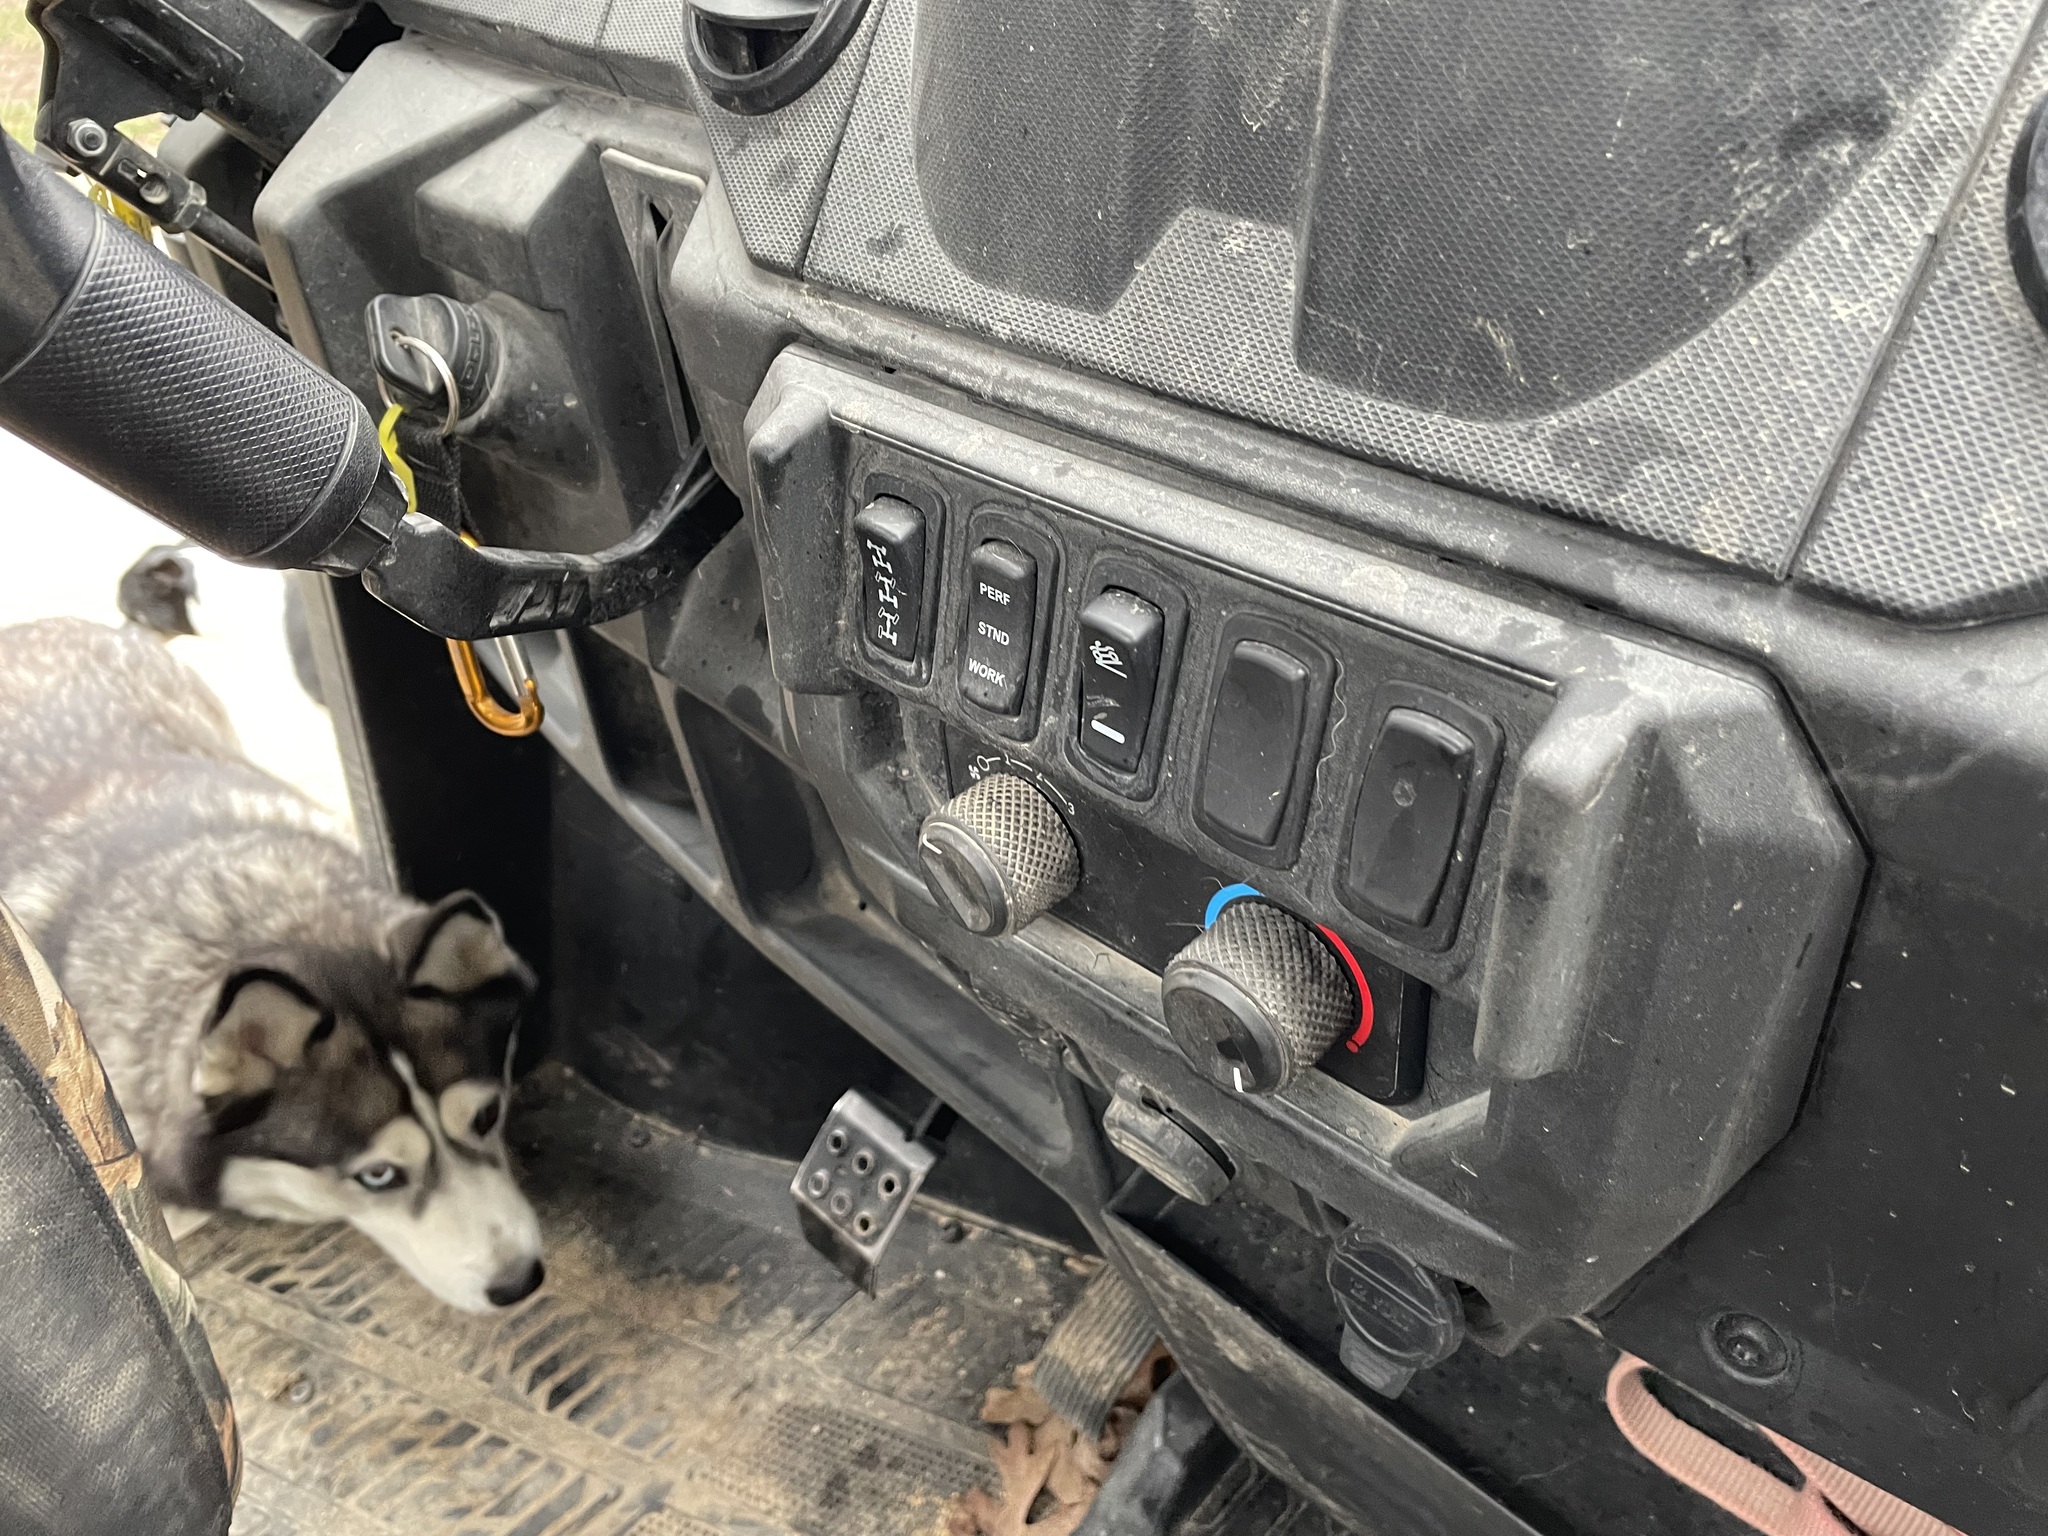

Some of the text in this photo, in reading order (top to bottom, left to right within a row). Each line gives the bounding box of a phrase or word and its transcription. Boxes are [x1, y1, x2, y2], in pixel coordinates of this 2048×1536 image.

[979, 582, 1011, 606] PERF
[978, 621, 1010, 646] STND
[968, 658, 1006, 687] WORK
